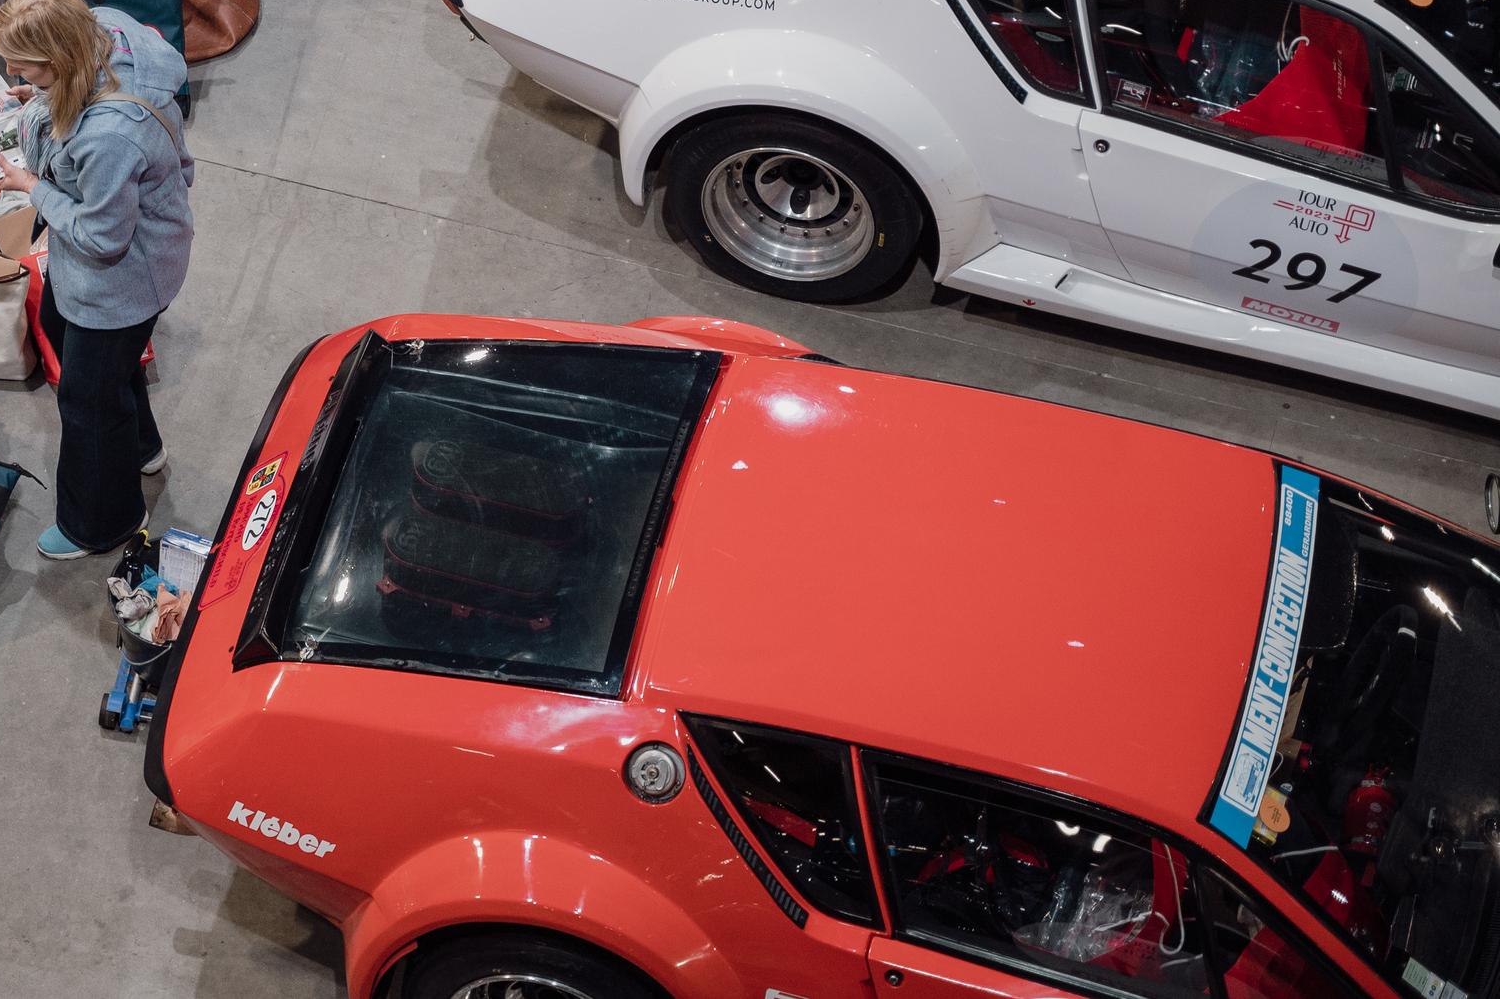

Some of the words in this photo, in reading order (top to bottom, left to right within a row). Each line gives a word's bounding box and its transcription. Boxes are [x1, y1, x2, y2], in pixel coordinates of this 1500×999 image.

[1295, 205, 1332, 221] 2023
[1298, 190, 1337, 211] TOUR
[1288, 215, 1329, 235] AUTO
[1232, 238, 1382, 303] 297
[1249, 300, 1335, 331] MOTUL
[244, 494, 275, 544] 272
[1284, 489, 1294, 527] 88400
[1242, 546, 1308, 752] MENY-CONFECTION
[227, 800, 337, 858] kléber
